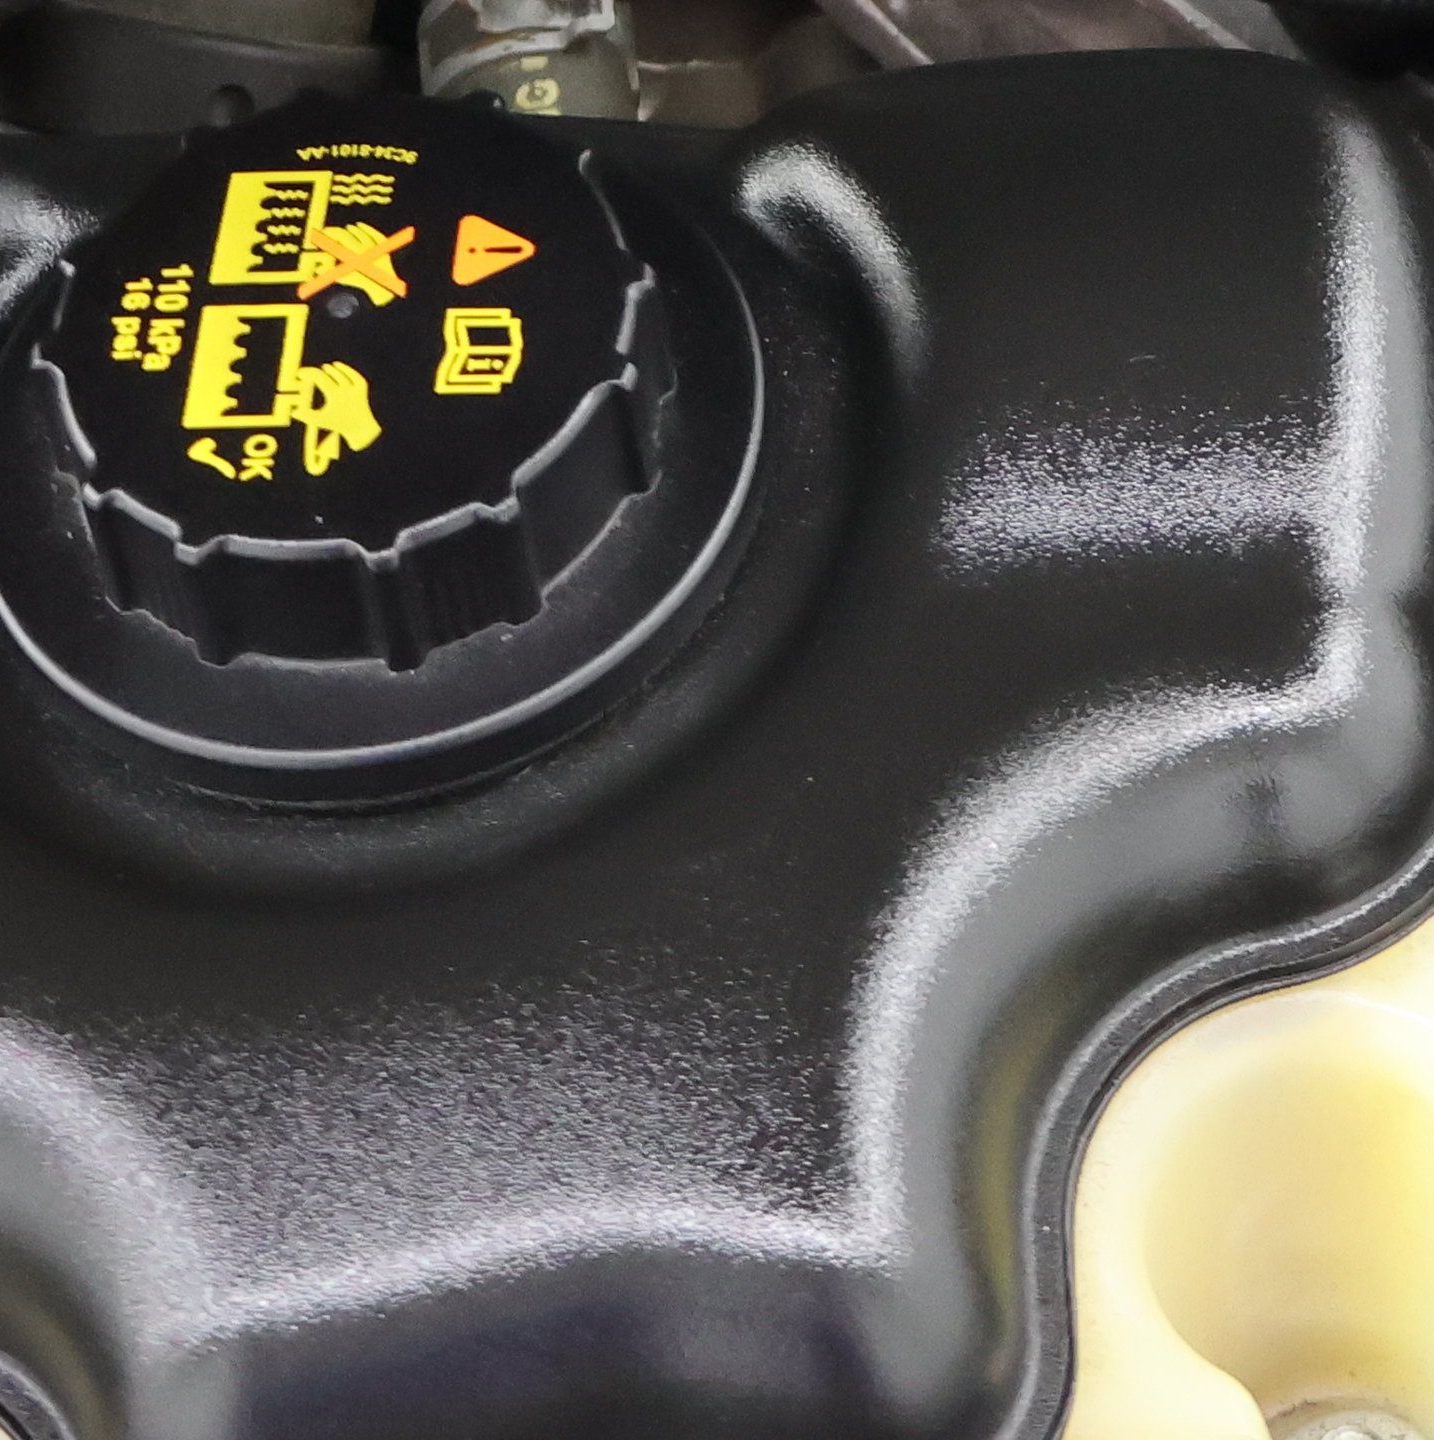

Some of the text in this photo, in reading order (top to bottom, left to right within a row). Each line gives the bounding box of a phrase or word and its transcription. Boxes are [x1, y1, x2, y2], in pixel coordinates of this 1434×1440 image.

[110, 277, 154, 361] 16 psi
[141, 263, 194, 371] 110 kPa
[238, 433, 279, 481] OK
